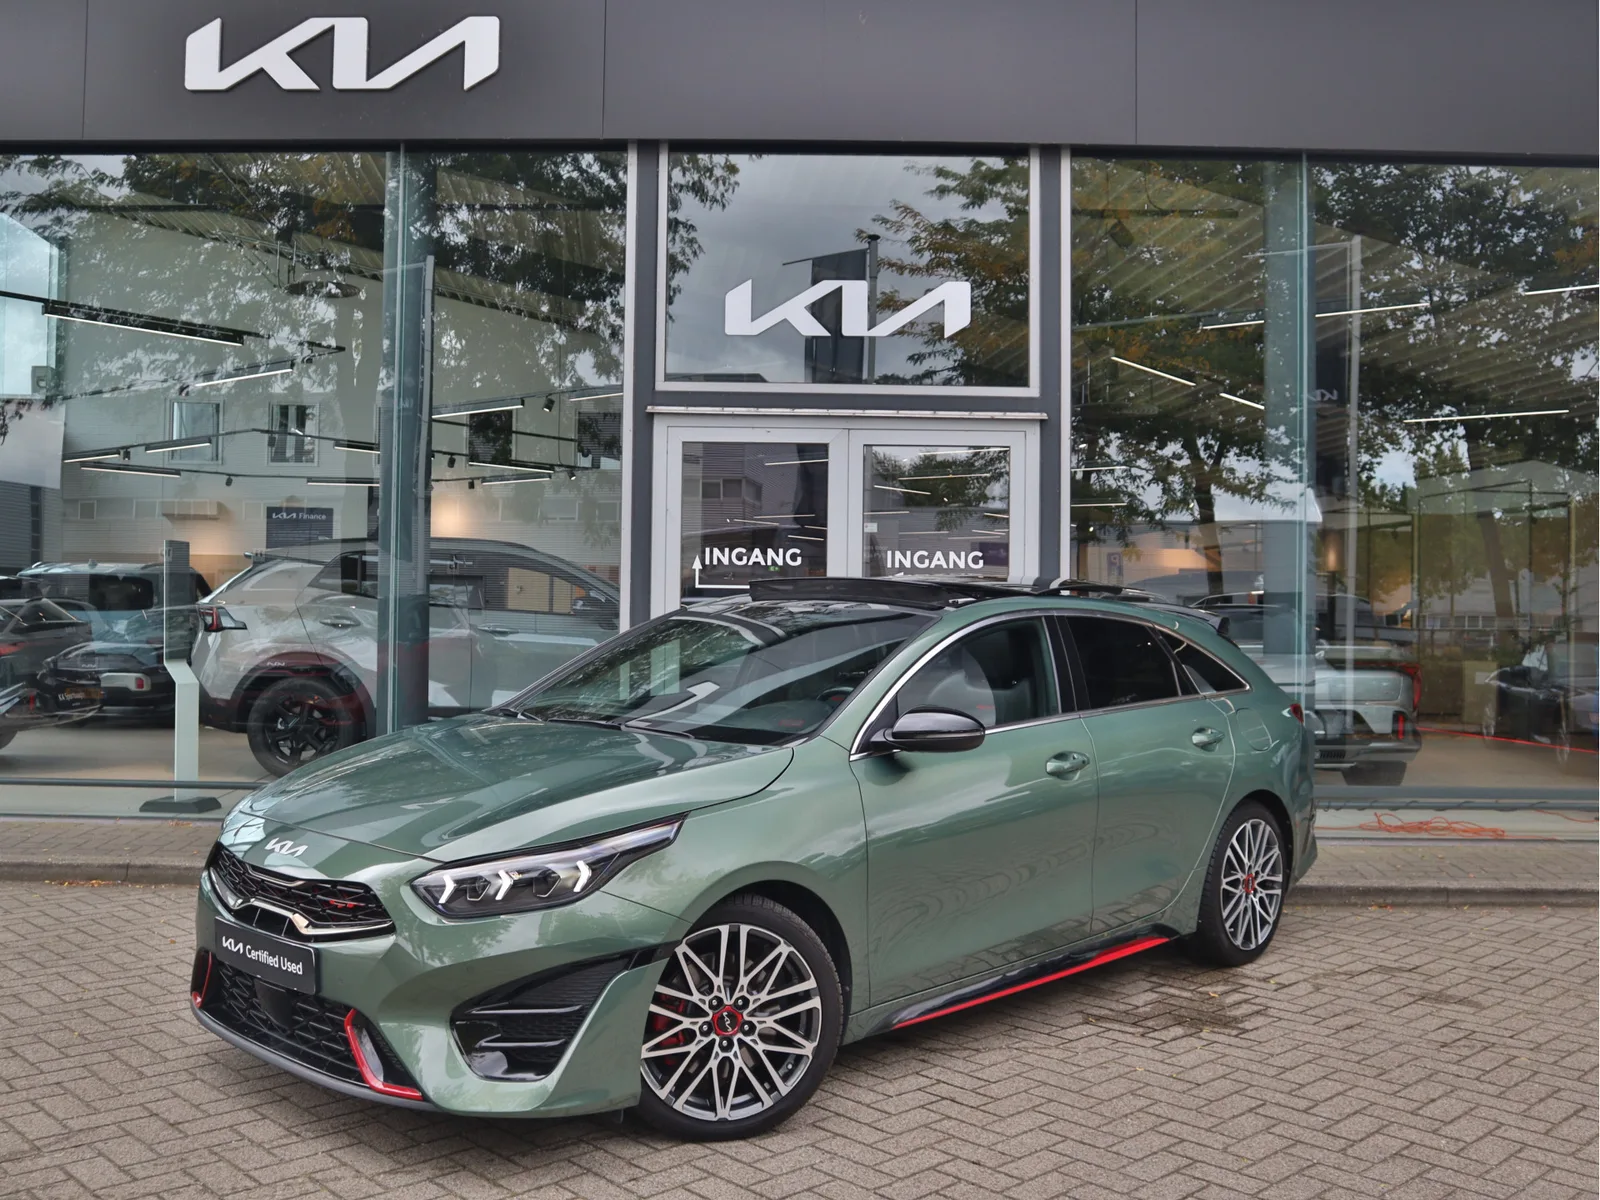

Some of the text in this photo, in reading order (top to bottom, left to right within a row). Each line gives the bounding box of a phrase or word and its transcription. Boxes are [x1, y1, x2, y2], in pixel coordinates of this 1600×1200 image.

[184, 16, 500, 91] KIA
[724, 278, 972, 338] KIA
[299, 512, 327, 520] Finance
[704, 547, 802, 566] INGANG
[886, 550, 984, 569] INGANG
[265, 837, 308, 857] KIA
[222, 935, 303, 975] KIA Certified Used
